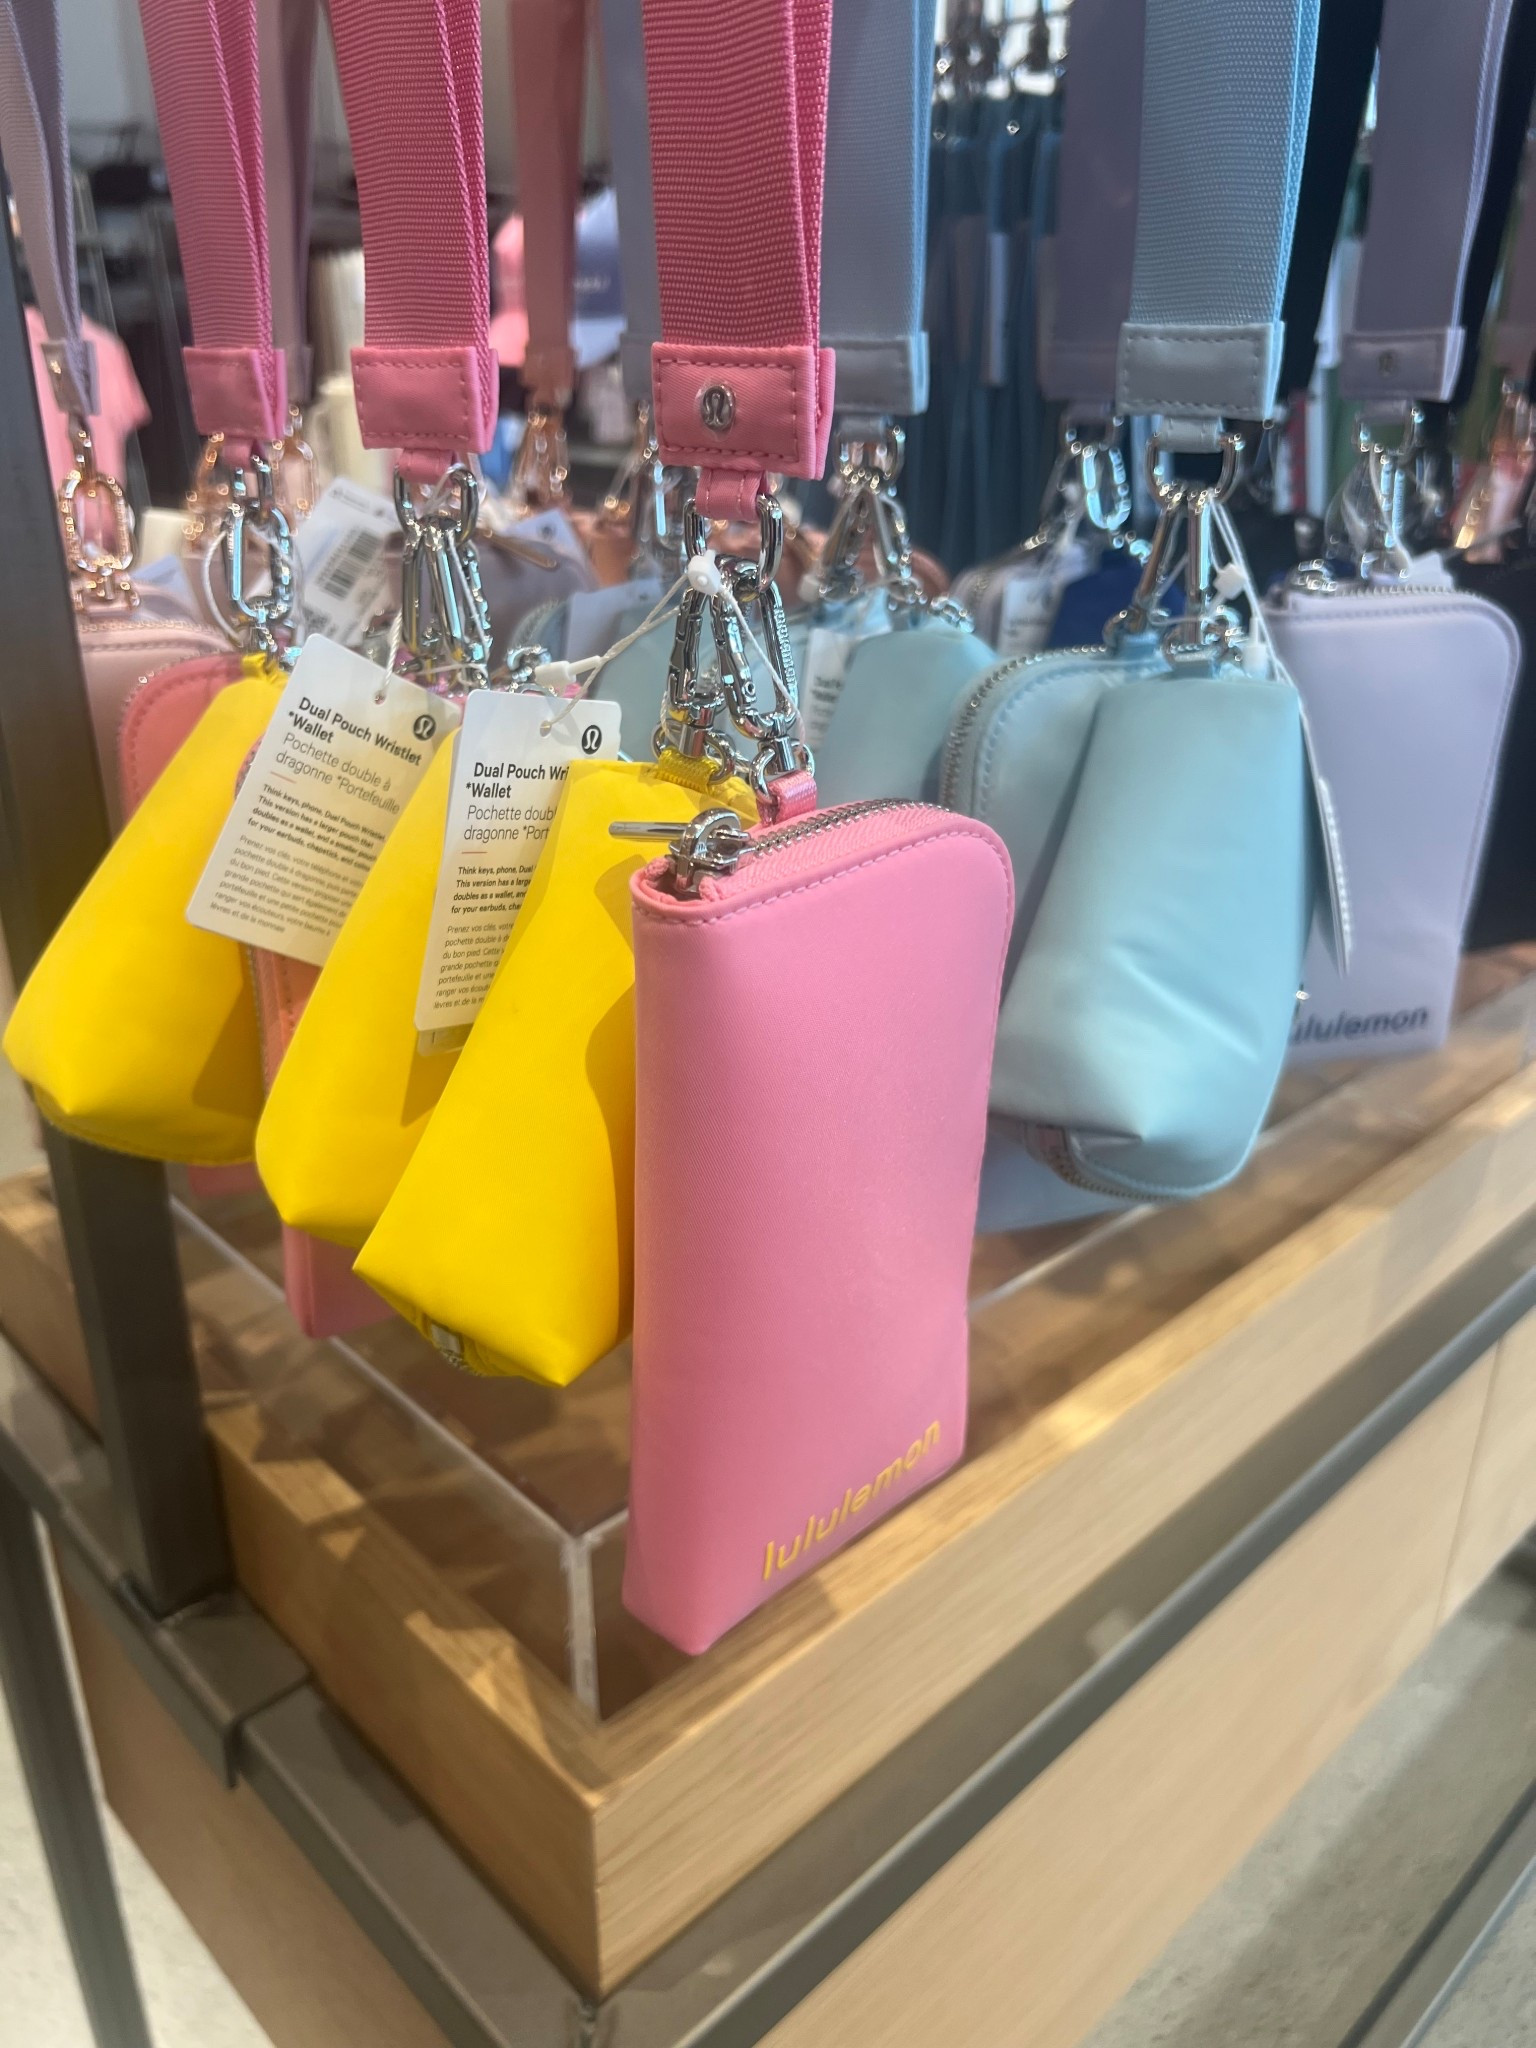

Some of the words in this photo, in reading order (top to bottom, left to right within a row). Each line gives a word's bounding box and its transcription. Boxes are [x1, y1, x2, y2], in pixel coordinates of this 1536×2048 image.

[298, 696, 332, 721] Dual
[331, 712, 372, 742] Pouch
[374, 733, 422, 766] Wristlet
[276, 750, 333, 784] dragonne
[283, 732, 339, 767] Pochette
[341, 760, 381, 787] double
[474, 762, 504, 778] Dual
[507, 764, 545, 780] Pouch
[259, 795, 273, 807] This
[467, 804, 521, 820] Pochette
[248, 817, 259, 827] for
[464, 825, 519, 844] dragonne
[478, 866, 495, 876] keys,
[444, 938, 474, 948] pochette
[440, 962, 463, 973] grande
[763, 1419, 940, 1581] lululemon
